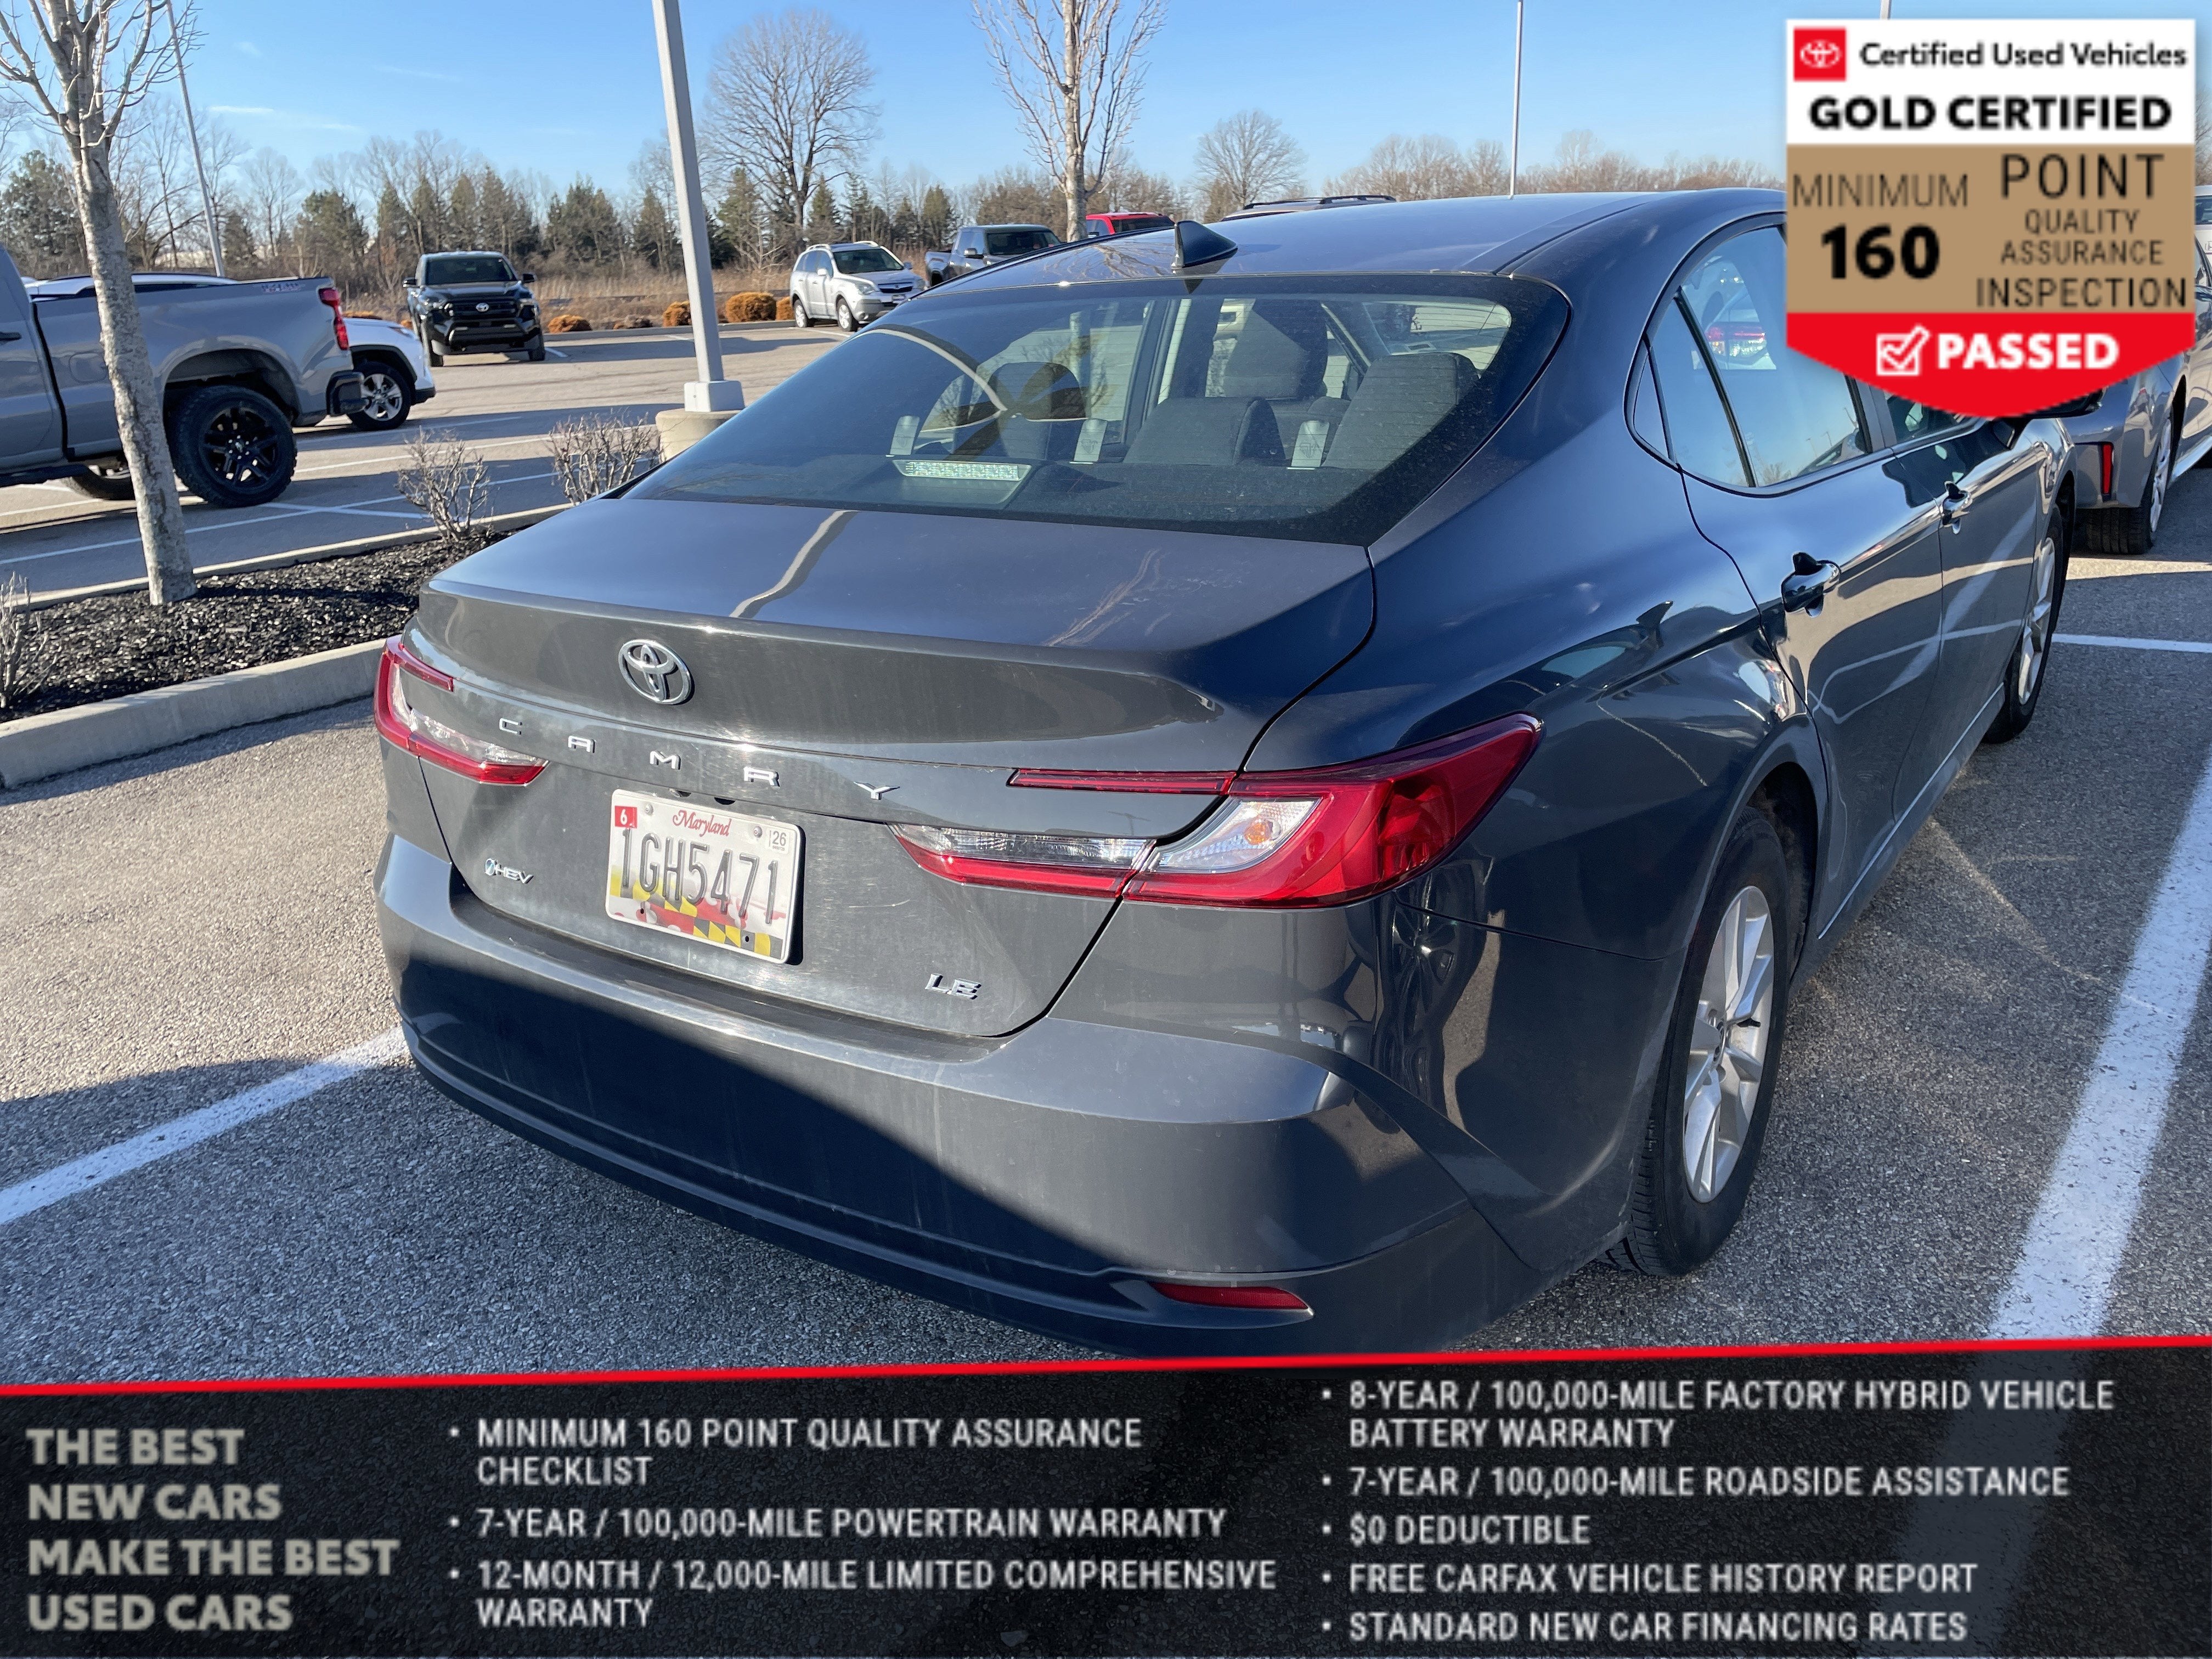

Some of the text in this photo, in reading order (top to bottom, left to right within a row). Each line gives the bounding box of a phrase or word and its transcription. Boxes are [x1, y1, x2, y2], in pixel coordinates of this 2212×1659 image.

[499, 716, 900, 801] CAMRY
[619, 808, 628, 825] 6
[673, 810, 733, 837] Maryland
[622, 827, 779, 926] 1GH5471
[925, 973, 981, 1000] LE
